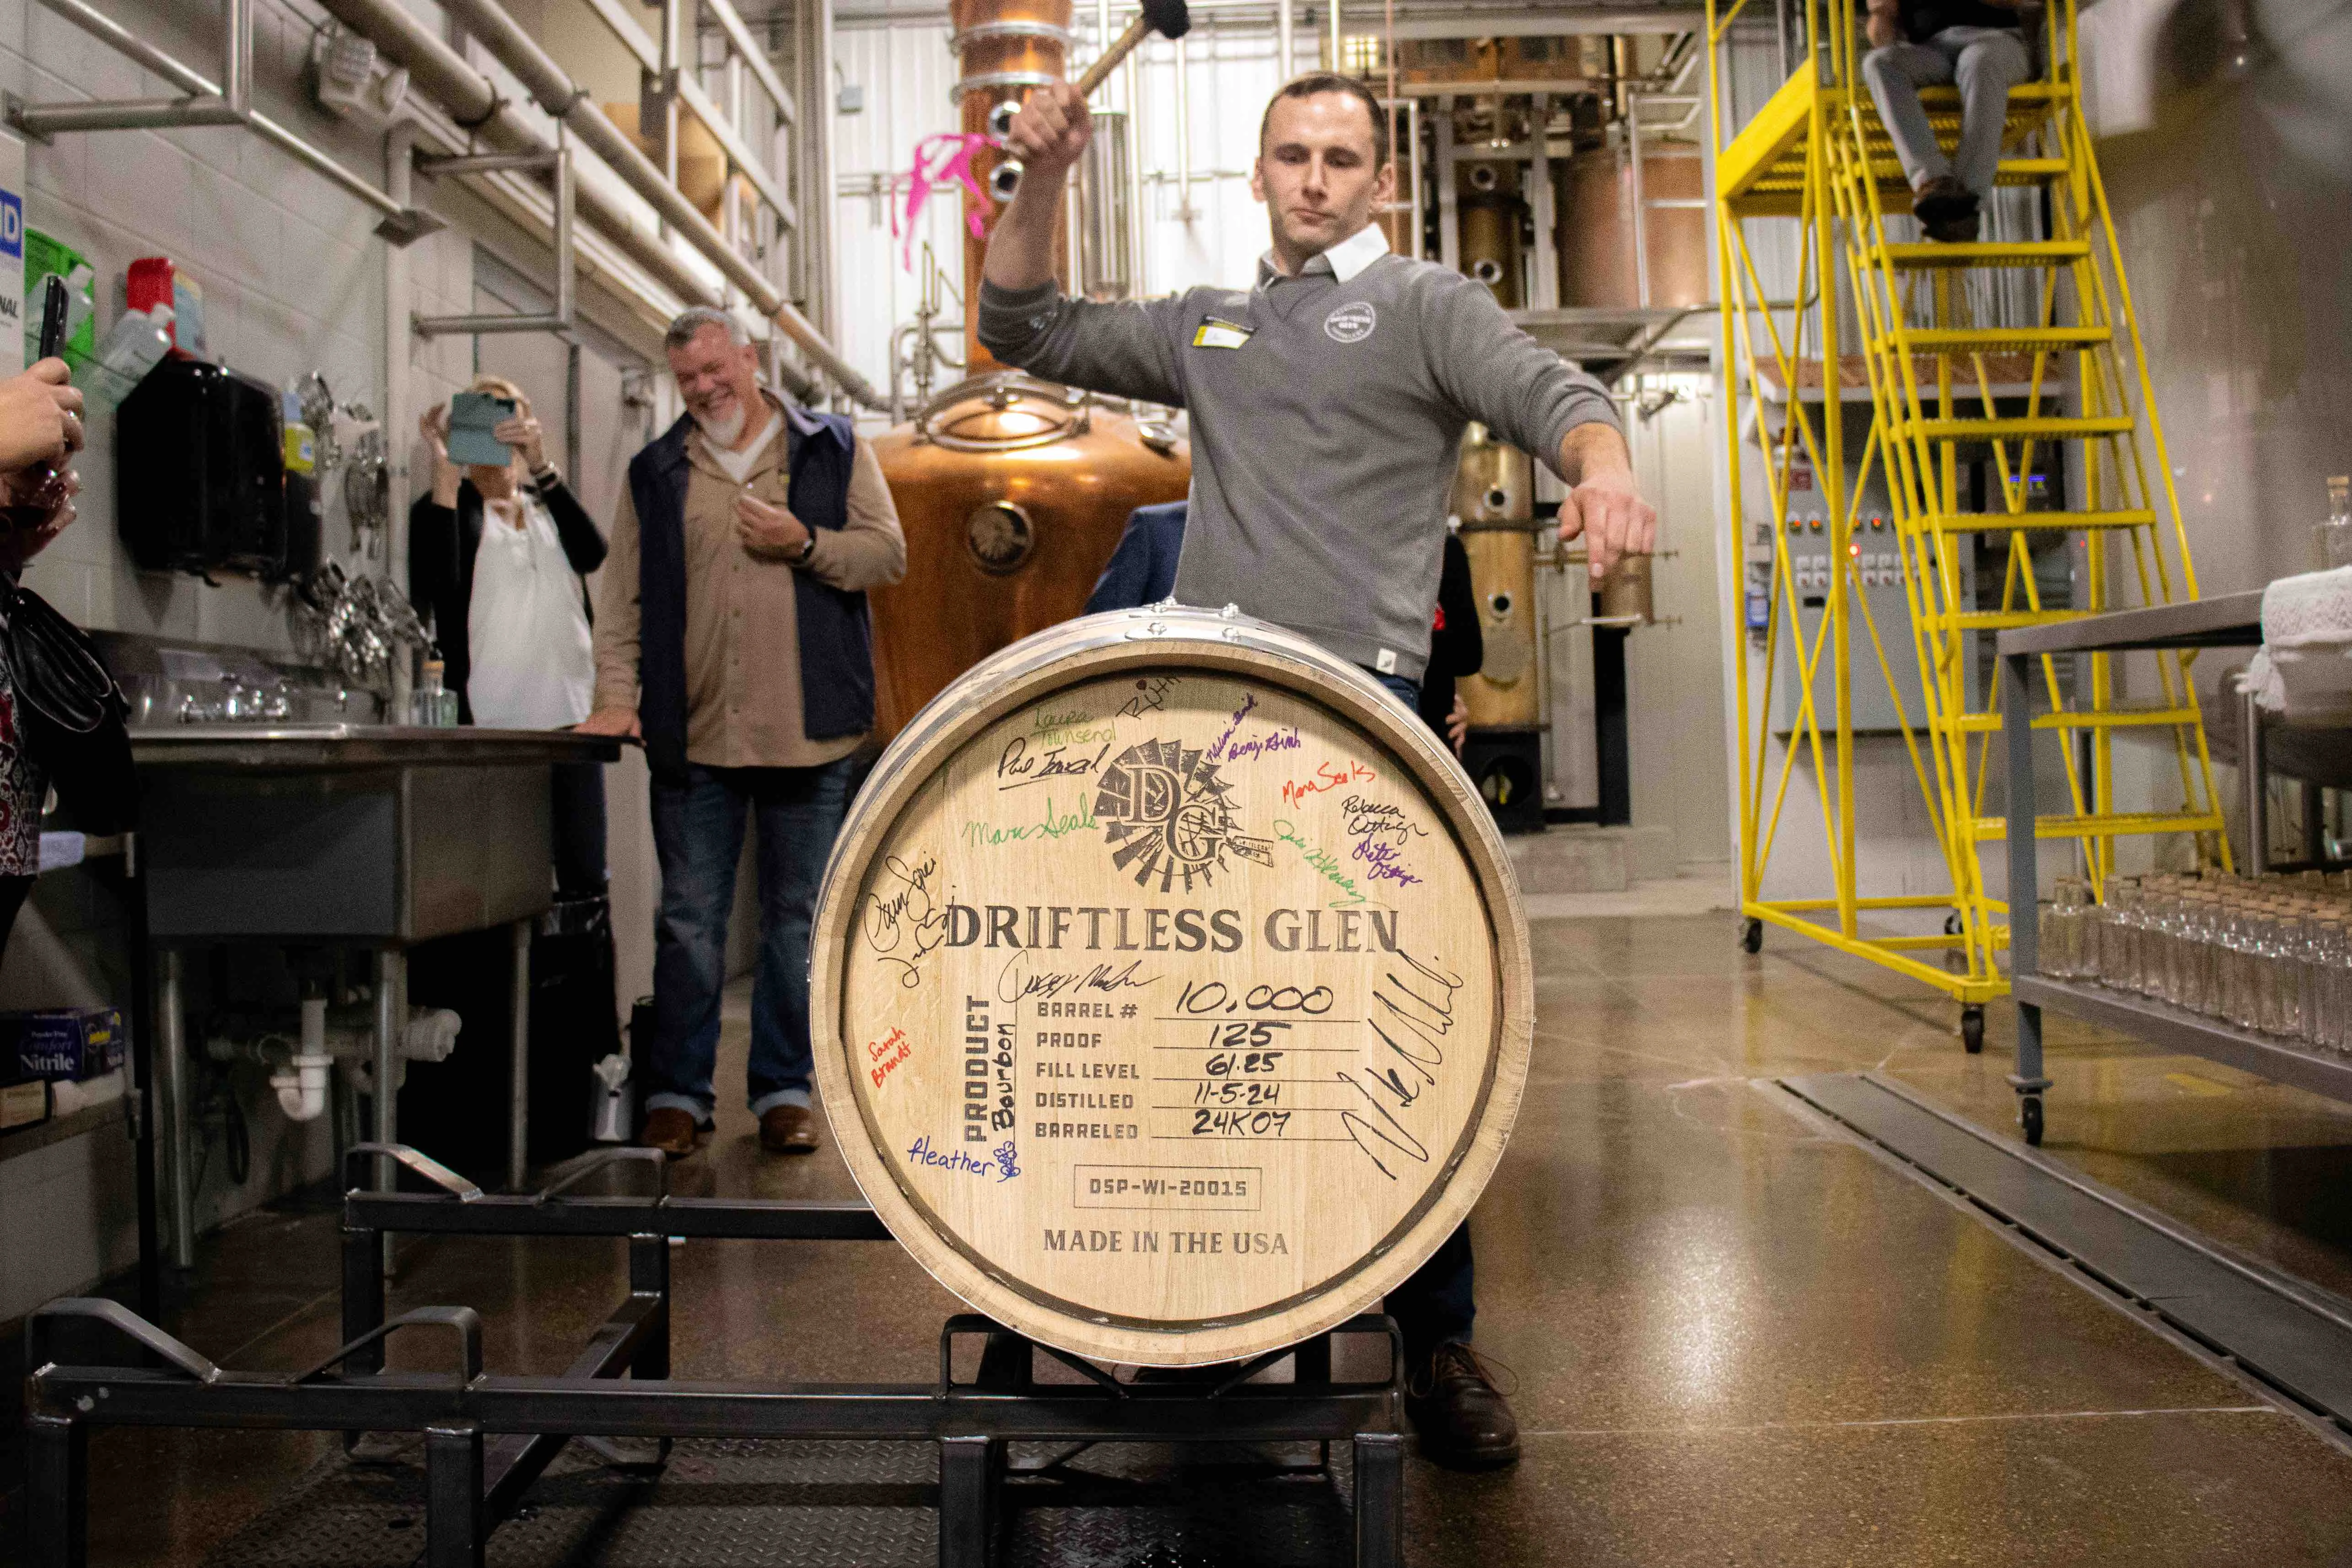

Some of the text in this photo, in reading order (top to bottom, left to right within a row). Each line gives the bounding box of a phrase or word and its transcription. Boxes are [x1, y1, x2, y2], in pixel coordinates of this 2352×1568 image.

[944, 904, 1399, 953] DRIFTLESS GLEN
[1037, 1002, 1114, 1018] BARREL
[1037, 1032, 1102, 1048] PROOF
[1210, 1021, 1292, 1047] 125
[20, 1053, 76, 1072] Nitrile
[964, 995, 990, 1142] PRODUCT
[1036, 1062, 1140, 1079] FILL LEVEL
[991, 1024, 1016, 1132] Bourbon
[1035, 1092, 1133, 1109] DISTILLED
[1035, 1122, 1138, 1139] BARRELED
[907, 1134, 996, 1176] Heather
[1090, 1178, 1246, 1196] DSP-WI-20015
[1044, 1229, 1288, 1254] MADE IN THE USA
